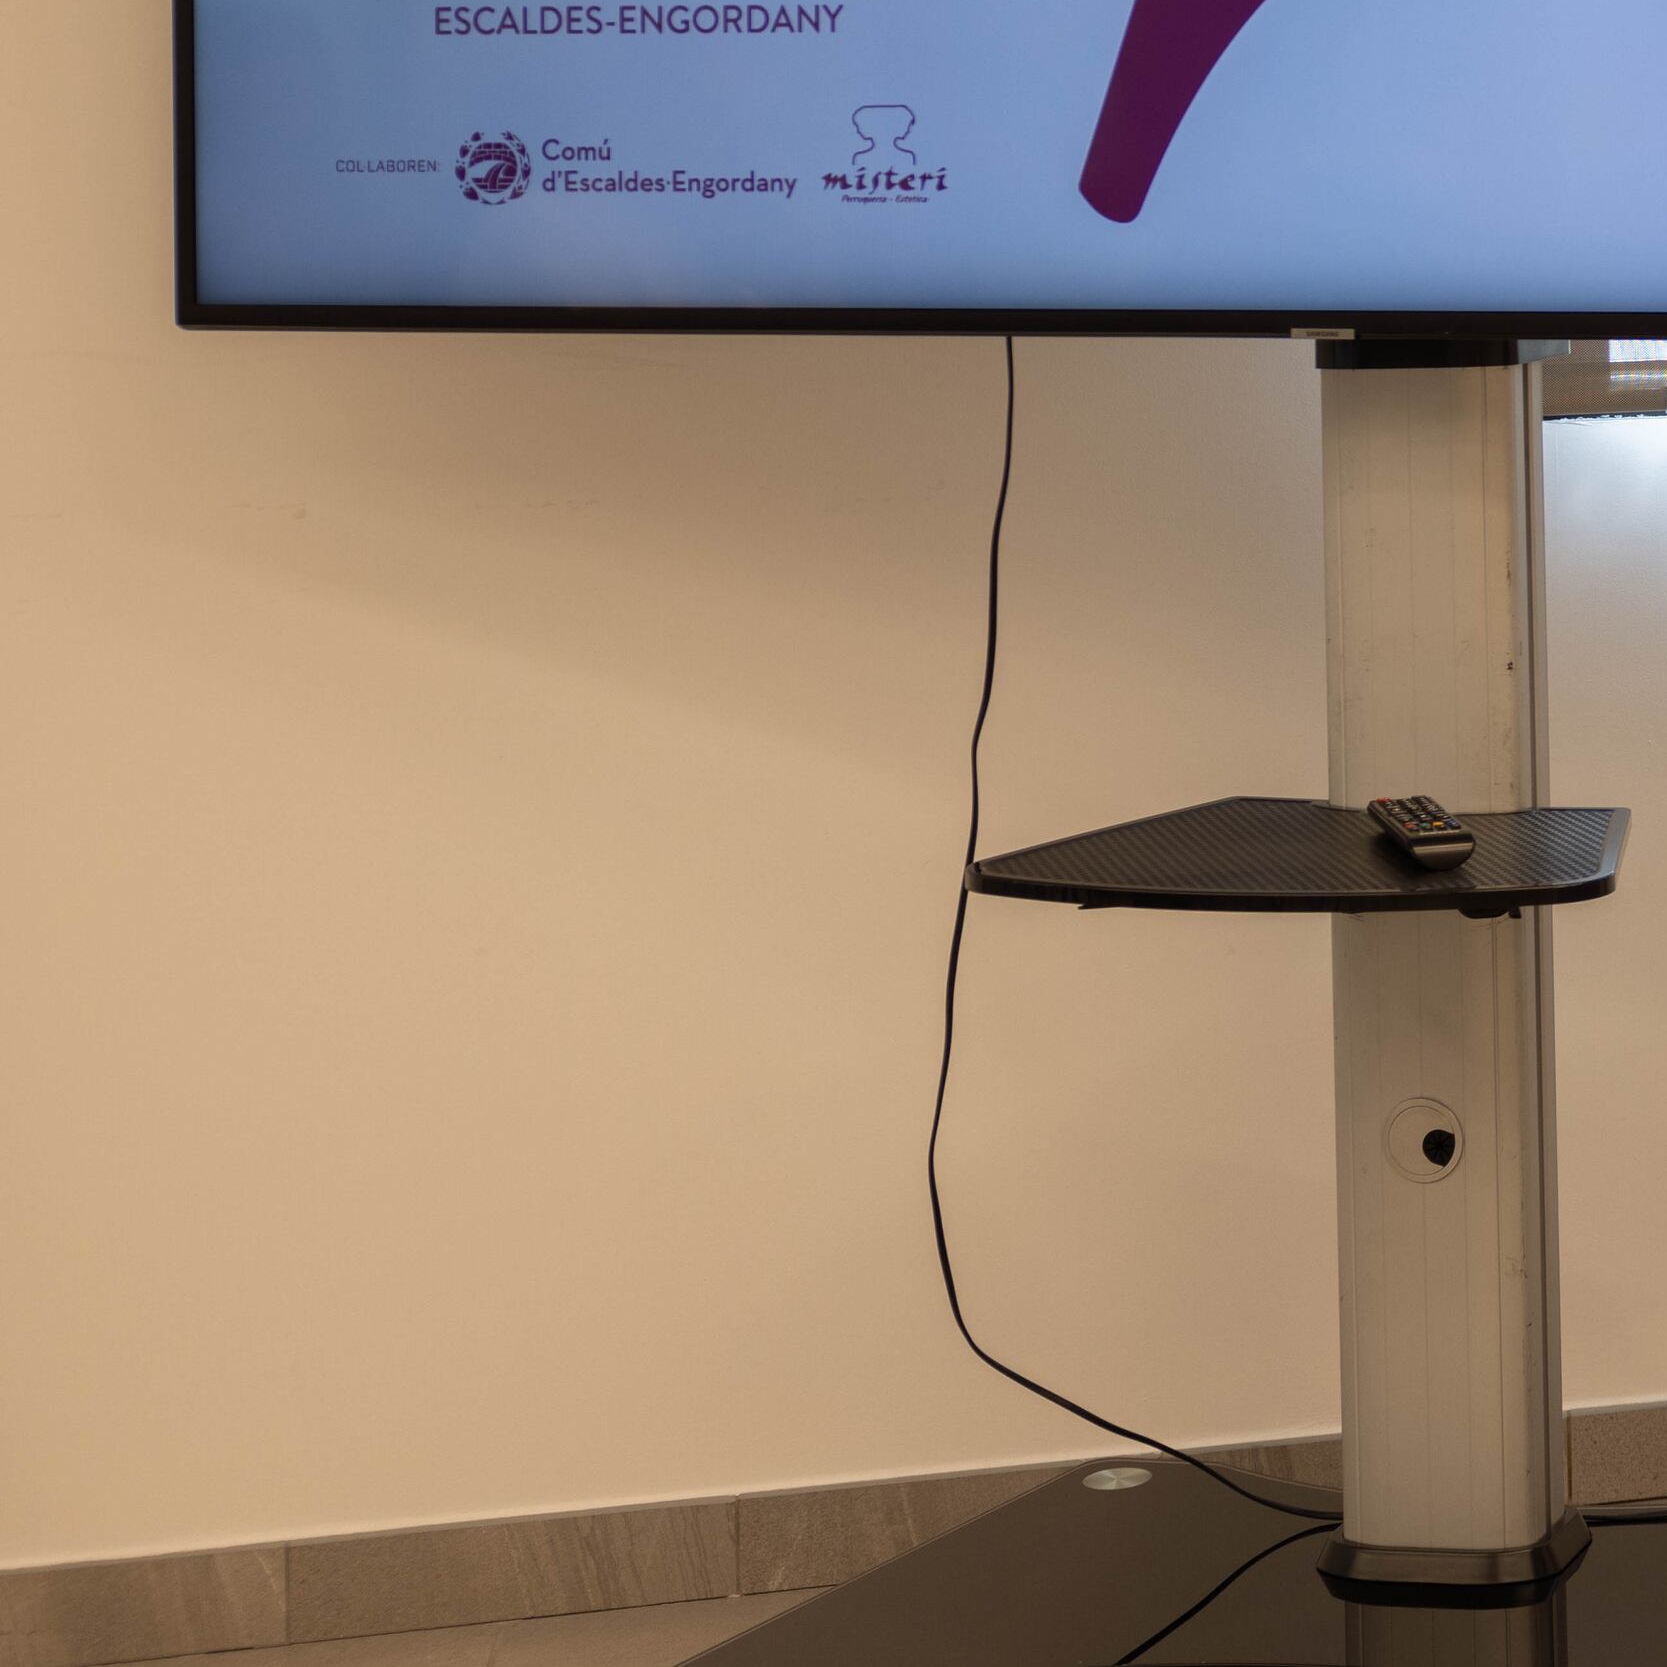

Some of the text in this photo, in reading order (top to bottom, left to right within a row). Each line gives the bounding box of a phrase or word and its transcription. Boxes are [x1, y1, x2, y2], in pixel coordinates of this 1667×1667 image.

[433, 4, 845, 37] ESCALDES-ENGORDANY
[541, 138, 612, 162] Comú
[821, 166, 949, 195] misteri
